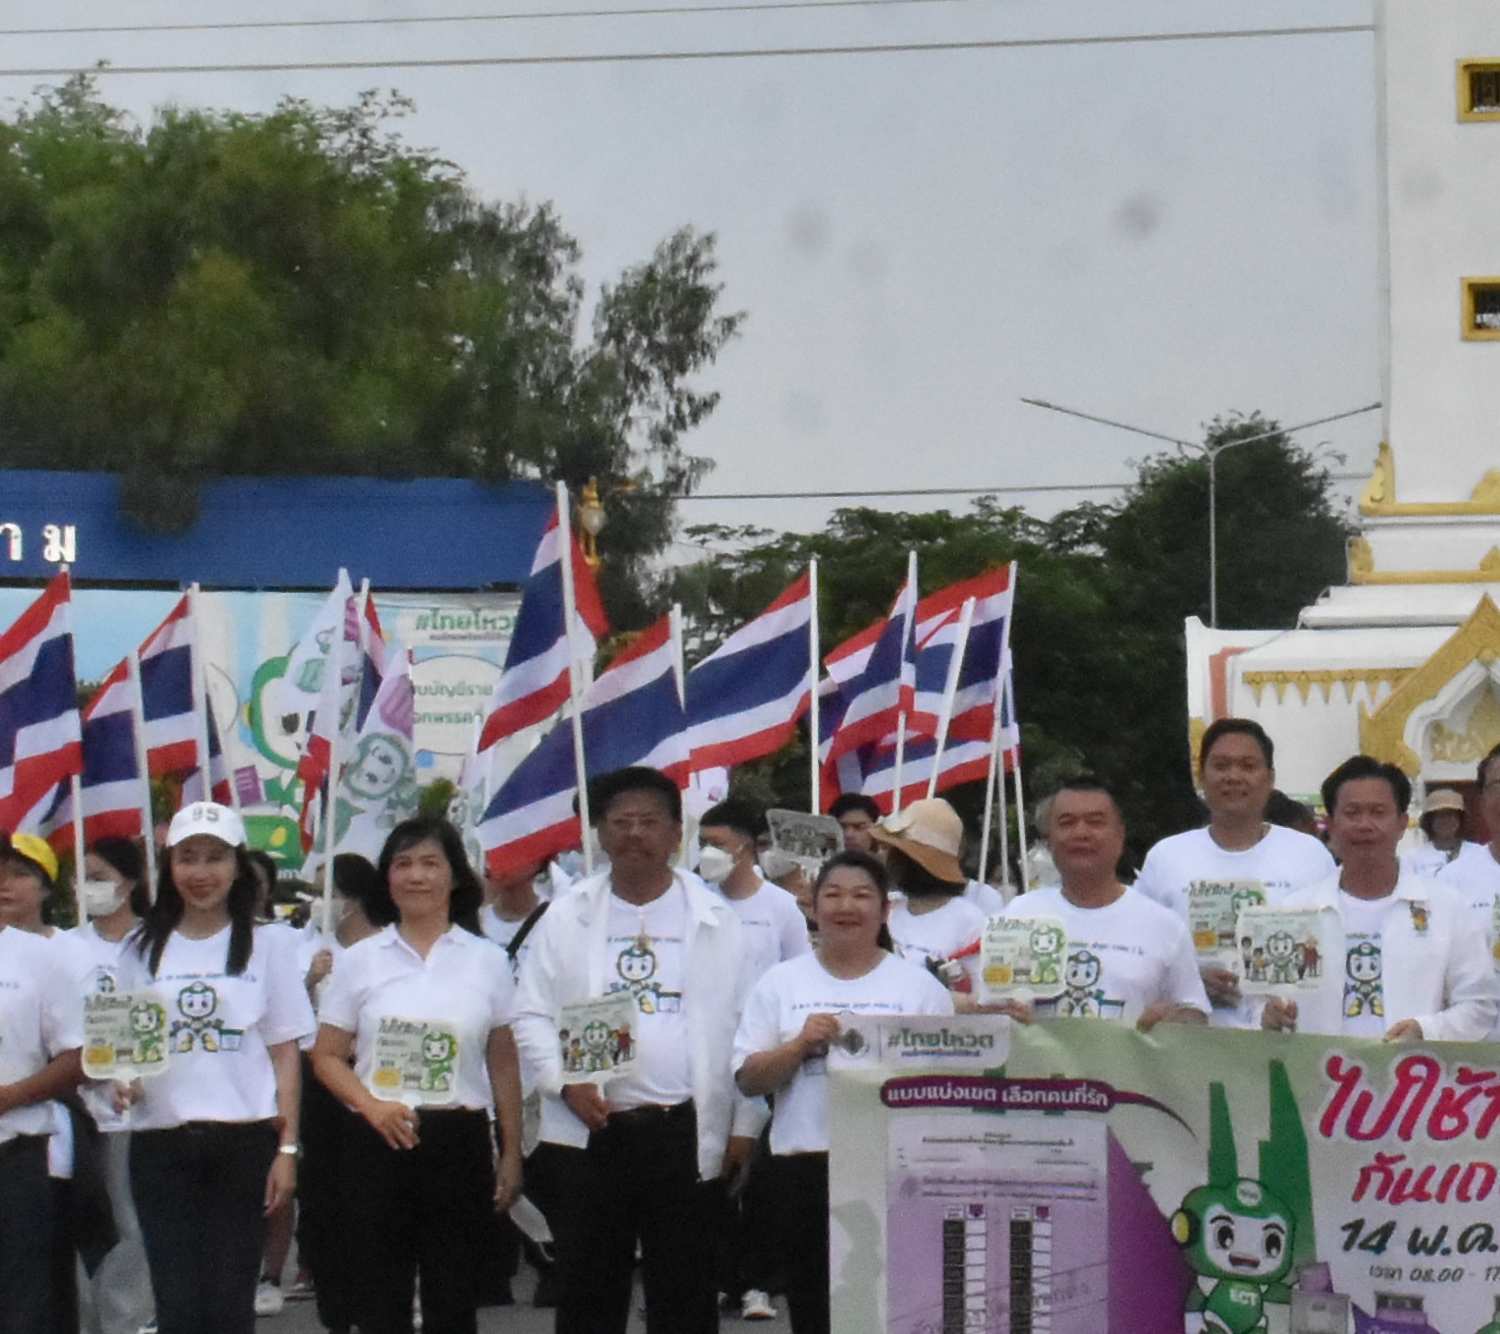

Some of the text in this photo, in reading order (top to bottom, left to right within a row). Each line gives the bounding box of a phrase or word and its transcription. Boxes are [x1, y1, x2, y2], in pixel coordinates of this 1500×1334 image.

[416, 607, 517, 632] #ไทยโหว
[887, 1081, 1109, 1108] แบบแบ่งเขต เลือกคนที่รัก
[1341, 1218, 1397, 1255] 14
[1407, 1224, 1500, 1257] พ.ค.
